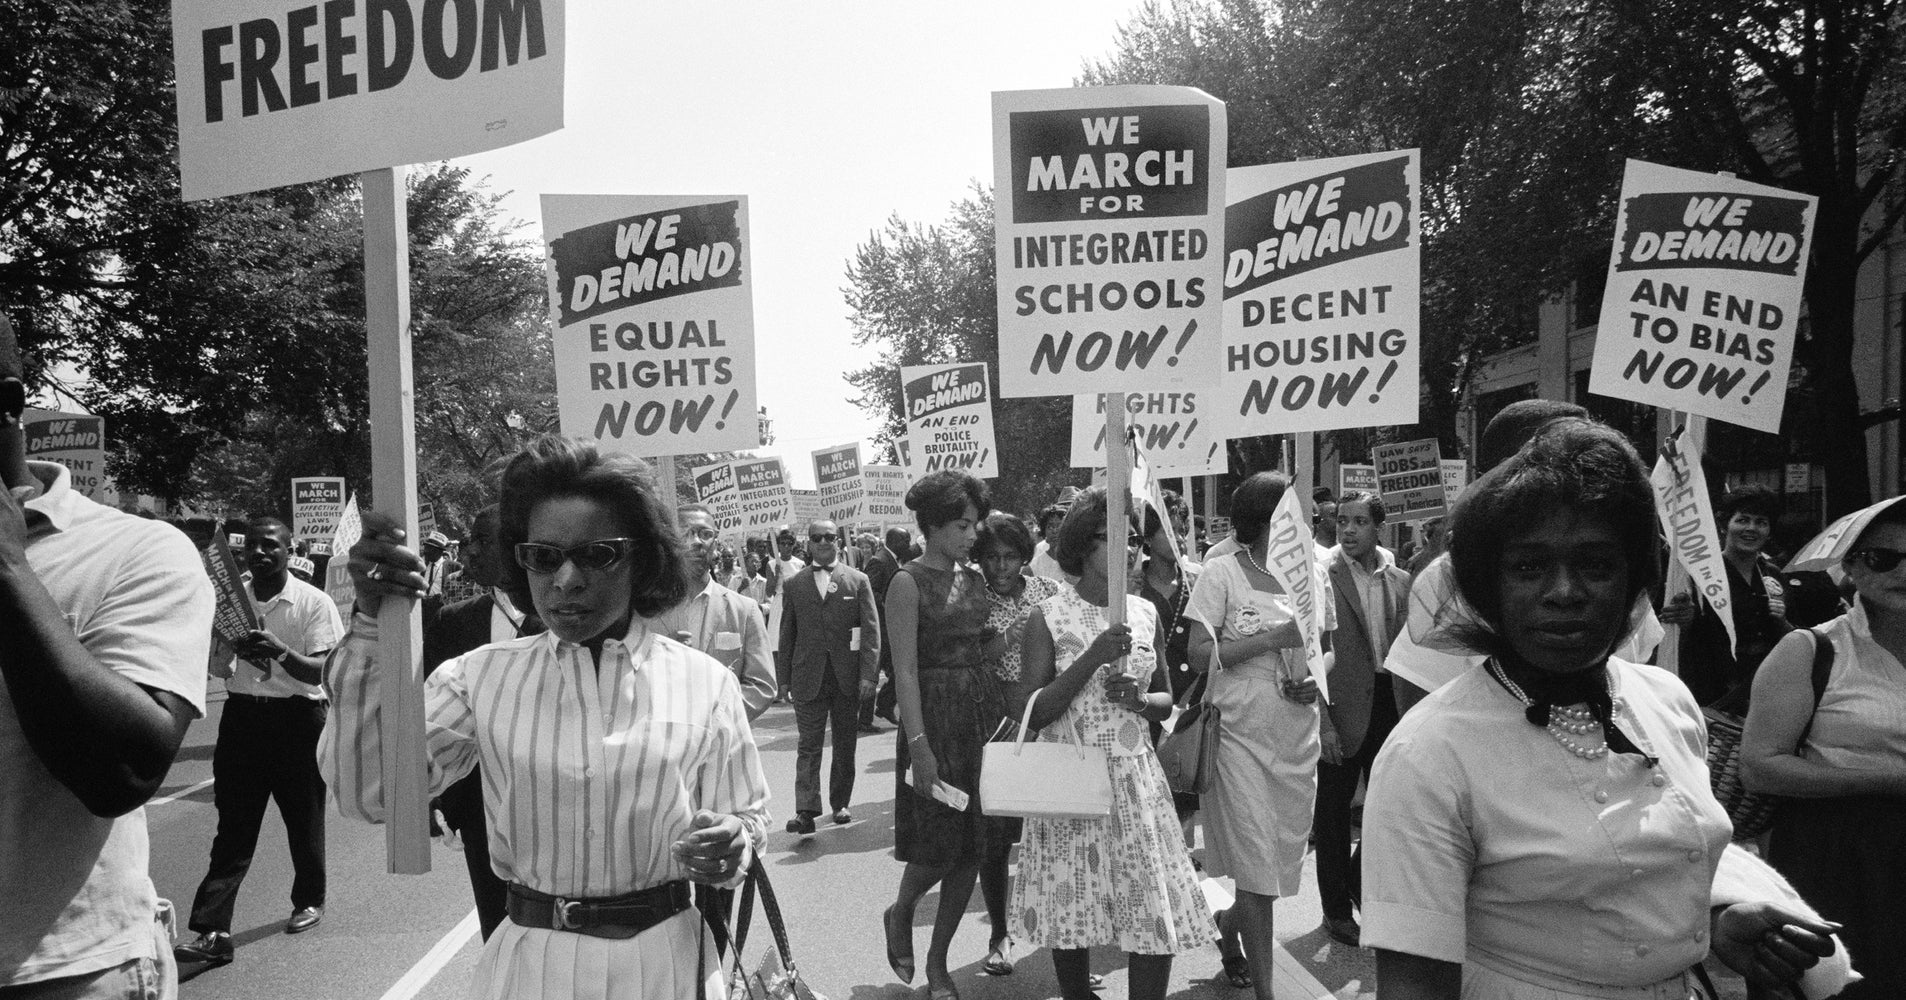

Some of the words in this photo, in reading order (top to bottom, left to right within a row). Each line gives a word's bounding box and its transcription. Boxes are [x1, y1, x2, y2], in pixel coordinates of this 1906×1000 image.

[202, 0, 546, 123] FREEDOM
[1081, 115, 1140, 146] WE
[1027, 149, 1194, 192] MARCH
[1080, 194, 1144, 213] FOR
[1273, 176, 1346, 231] WE
[1683, 196, 1752, 228] WE
[615, 214, 681, 260] WE
[1224, 200, 1403, 289] DEMAND
[1630, 229, 1796, 264] DEMAND
[1013, 228, 1208, 269] INTEGRATED
[570, 241, 736, 312] DEMAND
[1015, 277, 1206, 316] SCHOOLS
[1242, 285, 1392, 328] DECENT
[1629, 278, 1690, 312] AN
[1702, 290, 1784, 331] END
[589, 319, 726, 353] EQUAL
[1029, 318, 1198, 375] NOW!
[1630, 311, 1679, 344] TO
[1689, 323, 1776, 365] BIAS
[1227, 328, 1407, 372] HOUSING
[589, 356, 733, 391] RIGHTS
[931, 370, 960, 391] WE
[1622, 348, 1772, 405] NOW!
[1239, 358, 1399, 417] NOW!
[913, 381, 983, 416] DEMAND
[1096, 392, 1196, 414] RGHTS
[593, 388, 739, 440] NOW!
[920, 416, 945, 429] AN
[948, 414, 980, 426] END
[48, 420, 76, 434] WE
[934, 430, 971, 443] POLICE
[30, 432, 97, 451] DEMAND
[924, 441, 979, 455] BRUTALITY
[1380, 447, 1405, 459] UAW
[1407, 443, 1432, 454] SAYS
[821, 459, 856, 476] MARCH
[831, 452, 843, 462] WE
[925, 447, 989, 473] NOW!
[1379, 457, 1418, 475] JOBS
[1420, 457, 1437, 469] and
[711, 465, 729, 482] WE
[740, 470, 779, 484] MARCH
[751, 463, 765, 473] WE
[833, 472, 847, 480] FOR
[882, 471, 904, 479] RIGHTS
[310, 482, 325, 490] WE
[820, 485, 840, 497] FIRST
[841, 479, 862, 492] CLASS
[875, 483, 892, 491] FULL
[1345, 476, 1376, 484] MARCH
[1381, 471, 1441, 494] FREEDOM
[299, 489, 338, 498] MARCH
[707, 496, 721, 505] AN
[740, 486, 786, 502] INTEGRATED
[820, 489, 864, 507] CITIZENSHIP
[1403, 491, 1422, 499] FOR
[716, 502, 740, 513] POLICE
[742, 498, 789, 513] SCHOOLS
[829, 501, 863, 522] NOW!
[1406, 498, 1443, 511] American
[749, 508, 788, 526] NOW!
[208, 543, 231, 585] MARCH
[1268, 510, 1313, 621] FREEDOM
[1699, 566, 1712, 581] IN
[1705, 579, 1728, 611] '63
